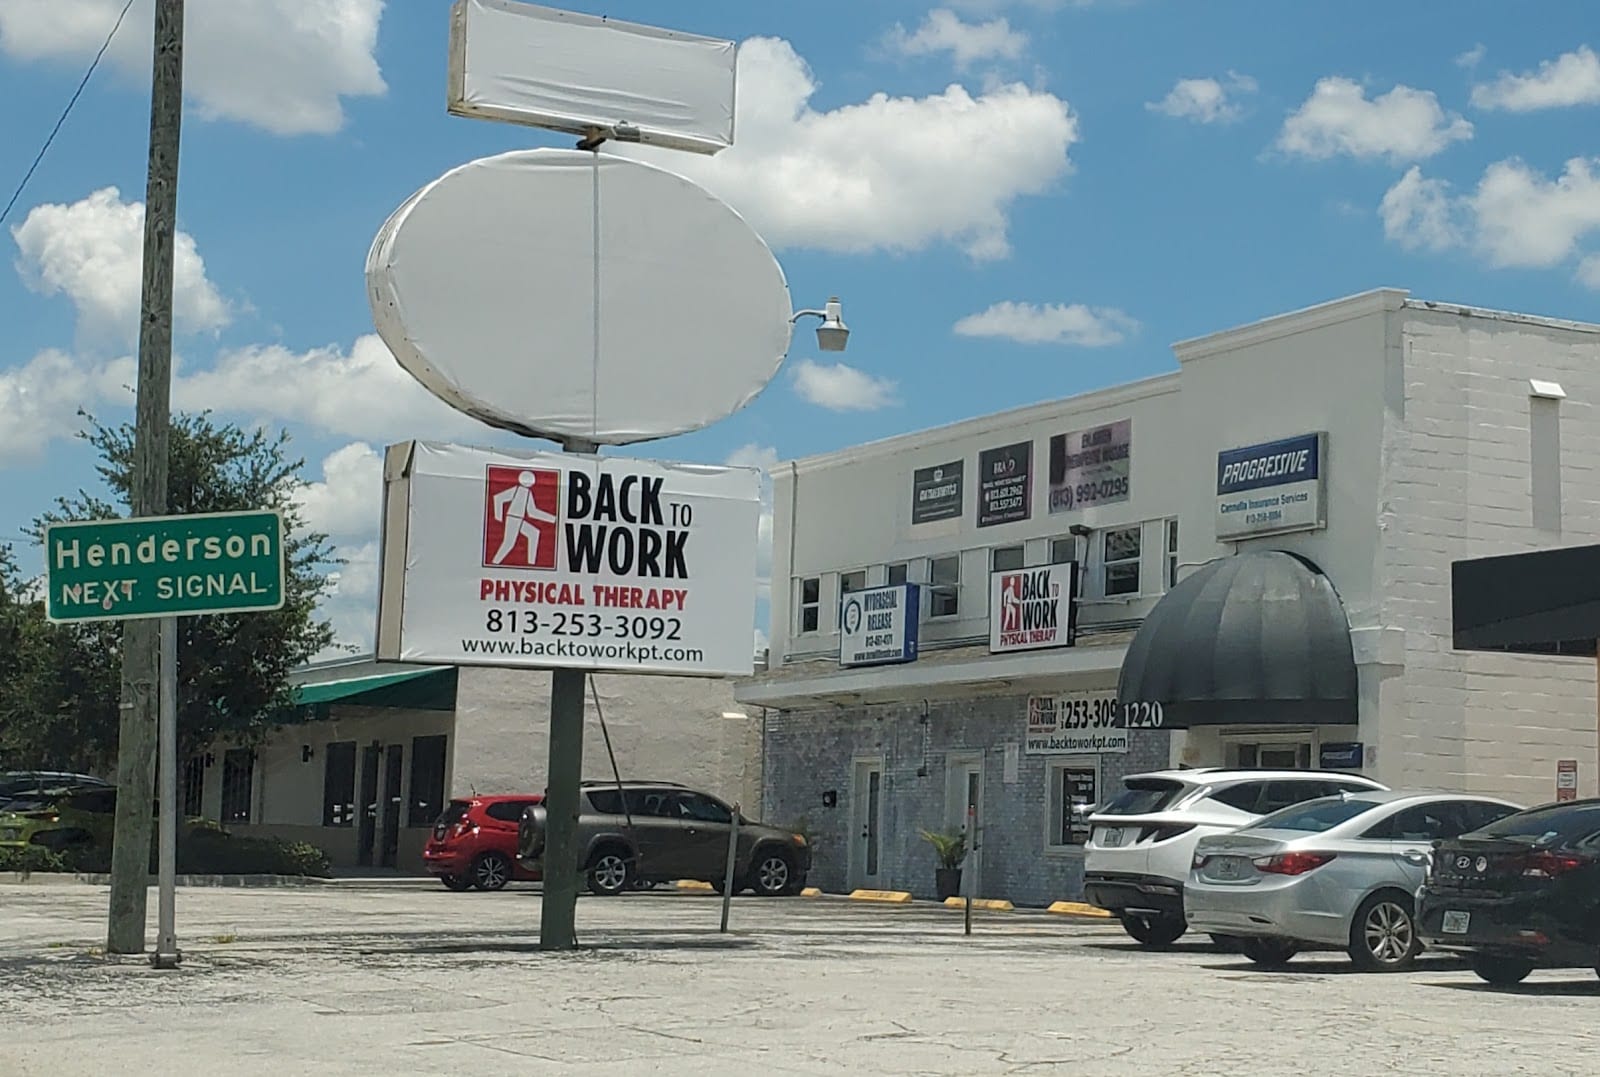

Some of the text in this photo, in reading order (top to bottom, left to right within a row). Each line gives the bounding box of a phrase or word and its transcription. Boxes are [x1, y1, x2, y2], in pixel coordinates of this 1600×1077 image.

[1222, 449, 1309, 485] PROGRESSIVE
[567, 470, 692, 527] BACK TO
[1076, 476, 1129, 502] 992-0295
[1281, 492, 1308, 505] Services
[56, 533, 271, 569] Henderson
[565, 523, 689, 579] WORK
[63, 572, 268, 605] NEXT SIGNAL
[480, 579, 688, 611] PHYSICAL THERAPY
[1022, 569, 1051, 601] BACK
[486, 609, 682, 640] 813-253-3092
[867, 611, 892, 631] RELEASE
[1022, 599, 1058, 631] WORK
[462, 637, 703, 663] www.backtoworkpt.com
[1000, 629, 1057, 646] PHYSICAL THERAPY
[1065, 699, 1118, 729] 253-309
[1123, 700, 1164, 728] 1220
[1028, 734, 1127, 752] www.backtoworkpt.com
